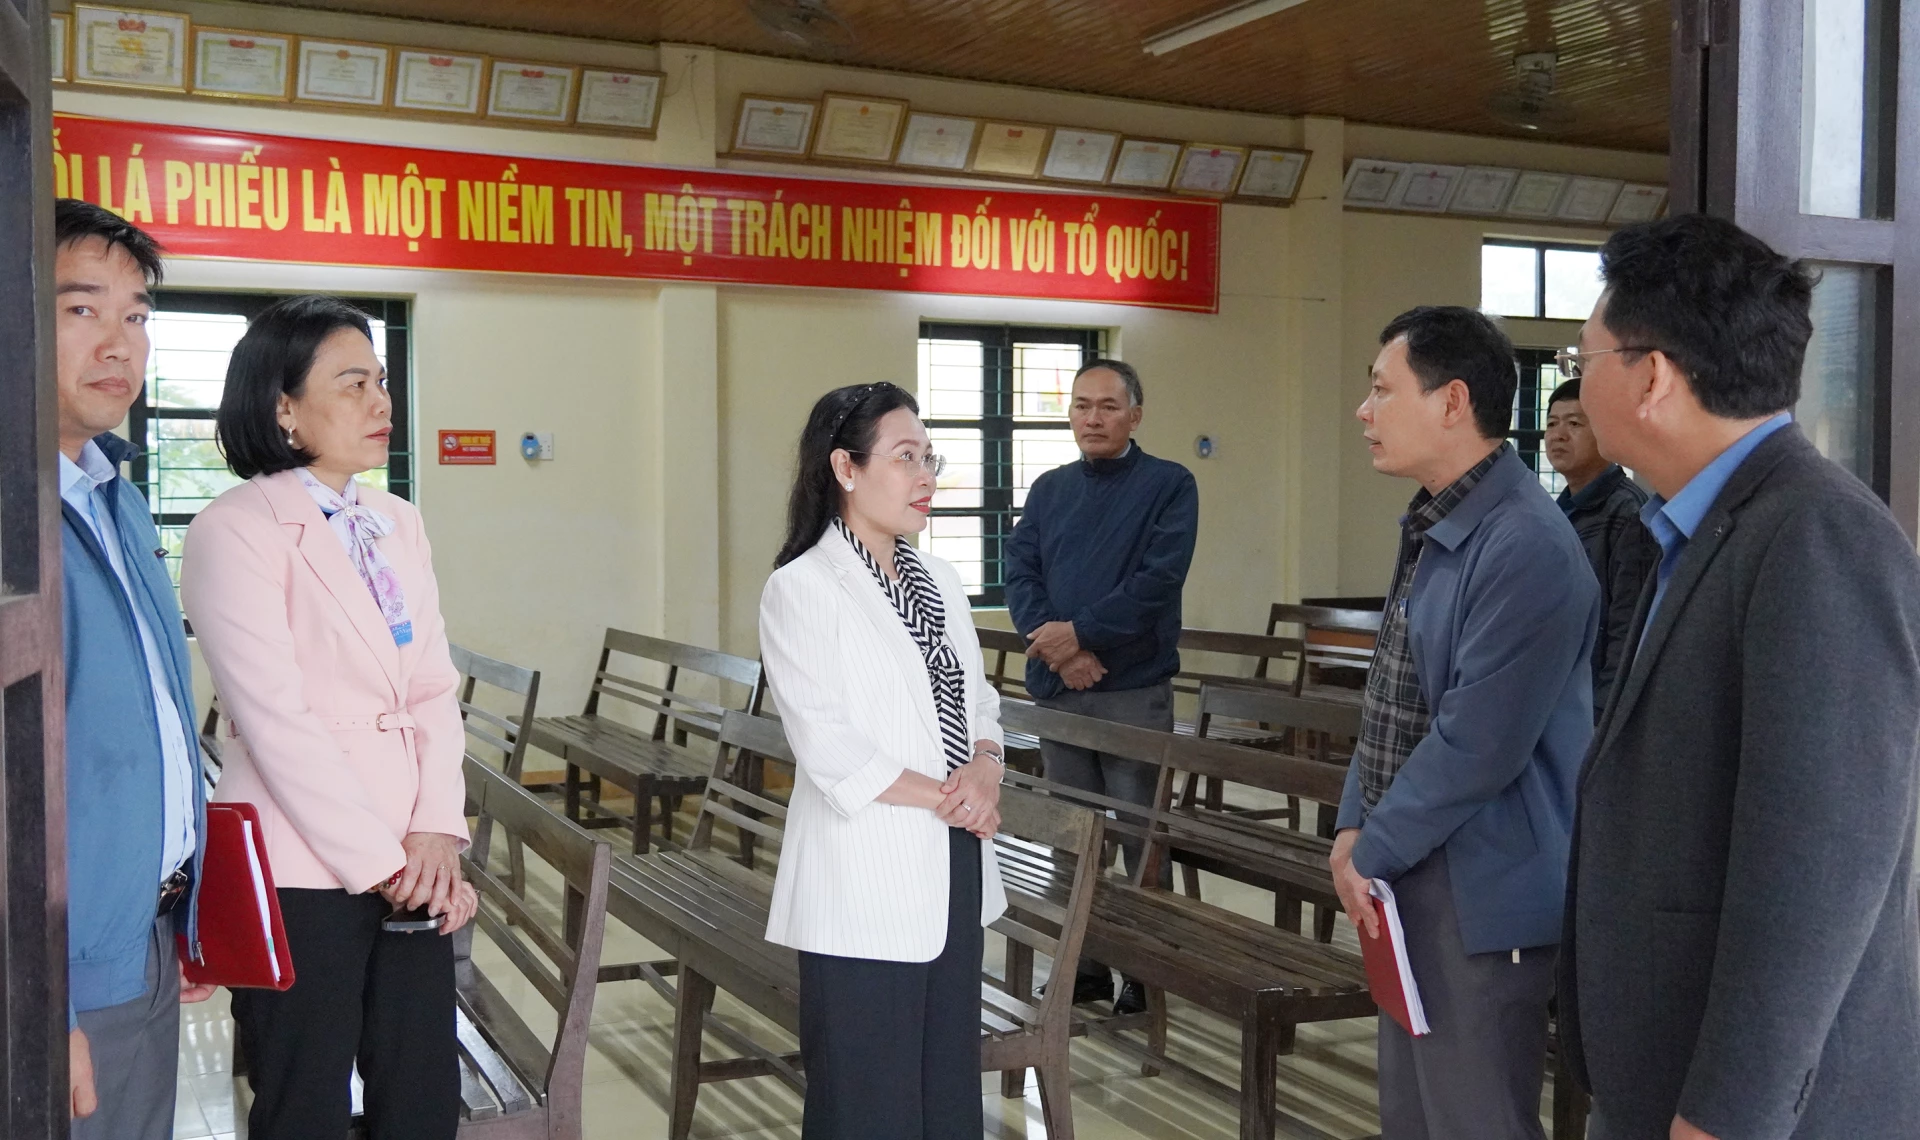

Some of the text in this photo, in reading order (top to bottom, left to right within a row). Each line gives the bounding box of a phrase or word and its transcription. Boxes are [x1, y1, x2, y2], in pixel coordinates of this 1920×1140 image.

[99, 143, 154, 223] LÁ
[165, 144, 288, 231] PHIẾU
[303, 157, 351, 235] LÀ
[363, 163, 447, 252] MỘT
[458, 163, 554, 245] NIỀM
[565, 187, 632, 256] TIN,
[645, 183, 718, 266] MỘT
[727, 190, 832, 260] TRÁCH
[842, 198, 942, 278] NHIỆM
[951, 197, 1000, 271] ĐỐI
[1010, 207, 1055, 273] VỚI
[1064, 202, 1099, 276] TỔ
[1106, 211, 1189, 283] QUỐC!
